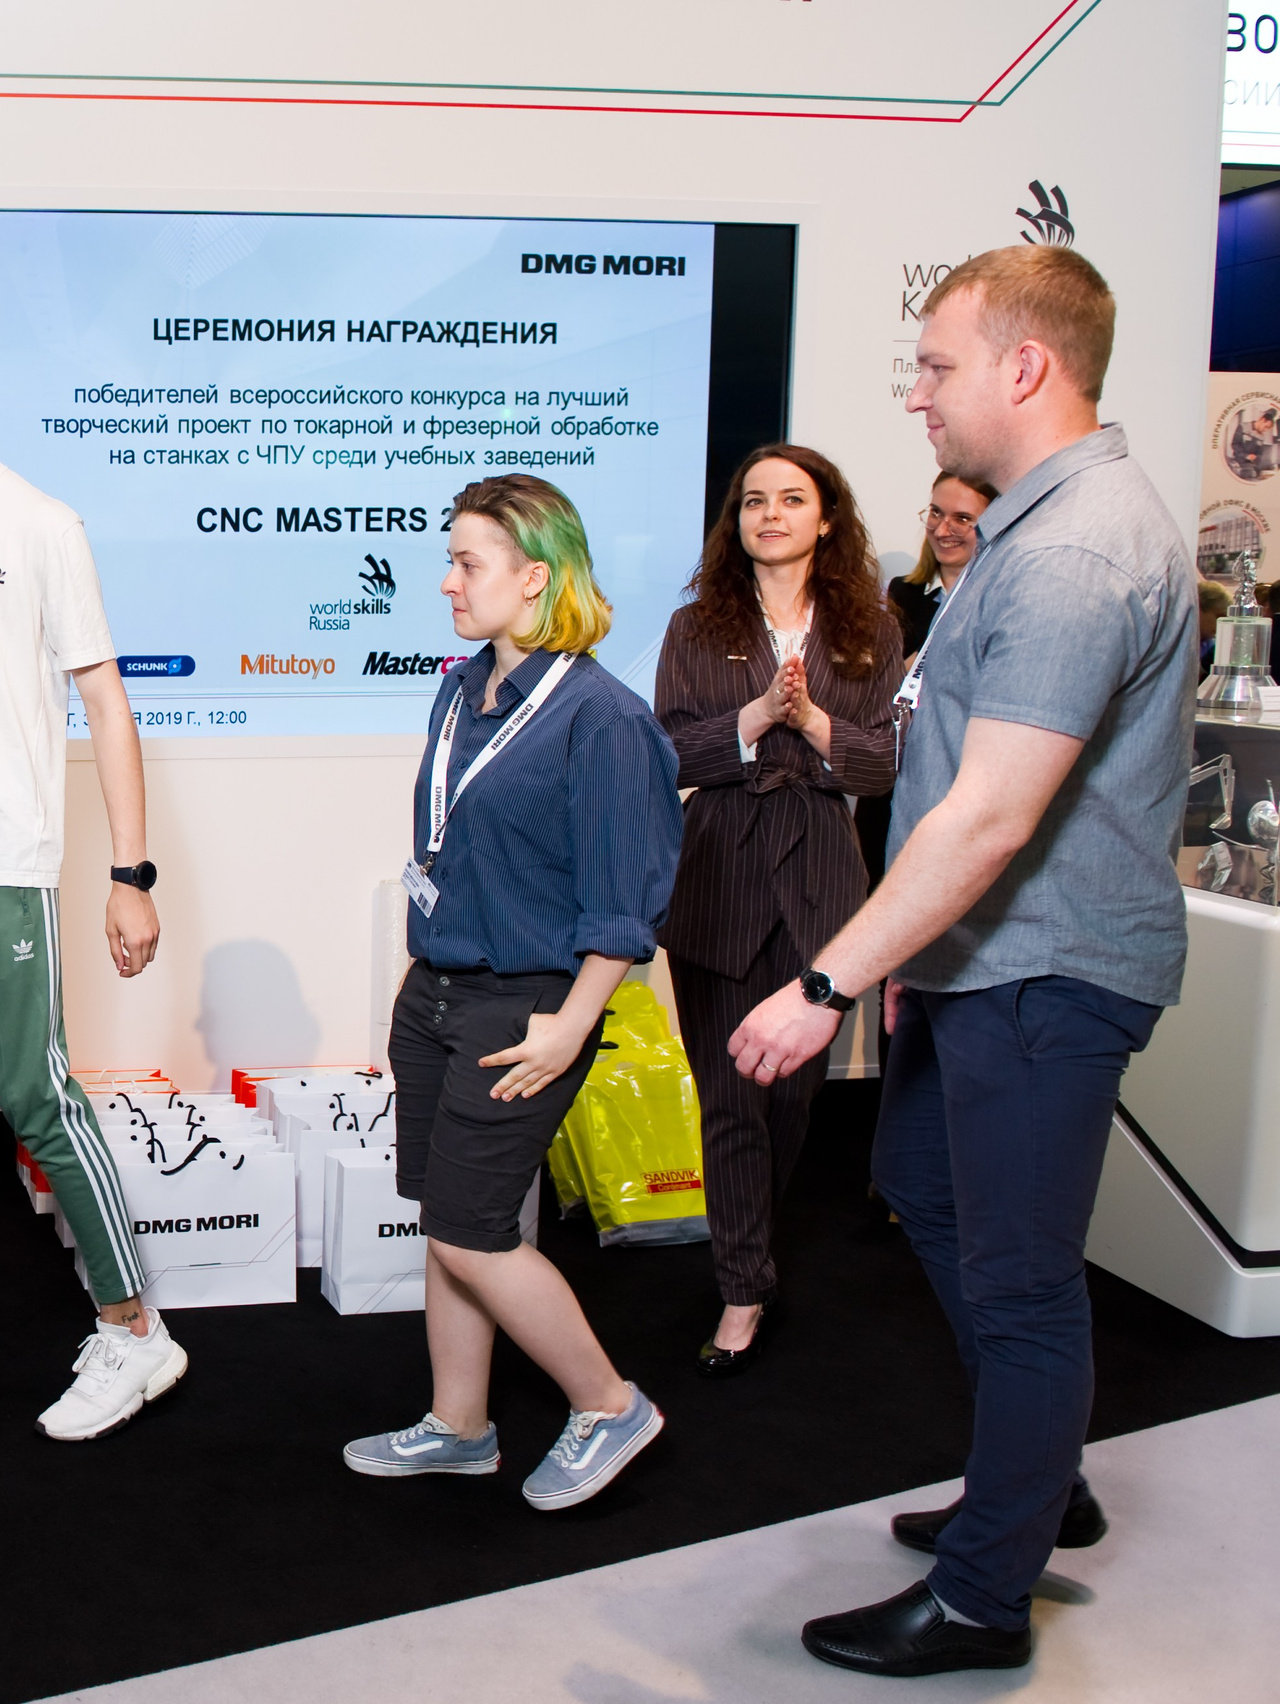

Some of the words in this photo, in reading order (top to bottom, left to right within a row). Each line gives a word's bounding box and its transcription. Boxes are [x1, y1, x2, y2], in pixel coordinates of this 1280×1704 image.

[521, 253, 597, 275] DMG
[603, 254, 687, 276] MORI
[153, 318, 336, 346] ЦЕРЕМОНИЯ
[346, 319, 558, 348] НАГРАЖДЕНИЯ
[892, 358, 922, 374] Пла
[74, 382, 219, 408] победителей
[229, 384, 404, 410] всероссийского
[411, 389, 506, 411] конкурса
[514, 390, 540, 406] на
[546, 386, 629, 411] лучший
[40, 413, 169, 439] творческий
[178, 418, 252, 439] проект
[261, 418, 288, 435] по
[293, 414, 393, 437] токарной
[403, 419, 416, 435] и
[422, 414, 541, 440] фрезерной
[550, 415, 660, 440] обработке
[109, 449, 136, 465] на
[143, 449, 230, 466] станках
[237, 449, 250, 465] с
[256, 444, 306, 465] ЧПУ
[312, 449, 377, 470] среди
[383, 444, 476, 470] учебных
[483, 445, 595, 469] заведений
[196, 506, 264, 534] CNC
[276, 506, 428, 533] MASTERS
[310, 614, 351, 631] Russia
[126, 662, 169, 672] SCHUNK
[240, 653, 336, 681] Mitutoyo
[146, 711, 183, 726] 2019
[207, 710, 247, 725] 12:00
[513, 703, 534, 727] DMG
[443, 715, 455, 741] MORI
[491, 724, 515, 751] MORI
[434, 786, 442, 812] DMG
[643, 1169, 699, 1184] SANDVIK
[134, 1218, 192, 1235] DMG
[196, 1213, 260, 1232] MORI
[378, 1222, 427, 1238] DM
